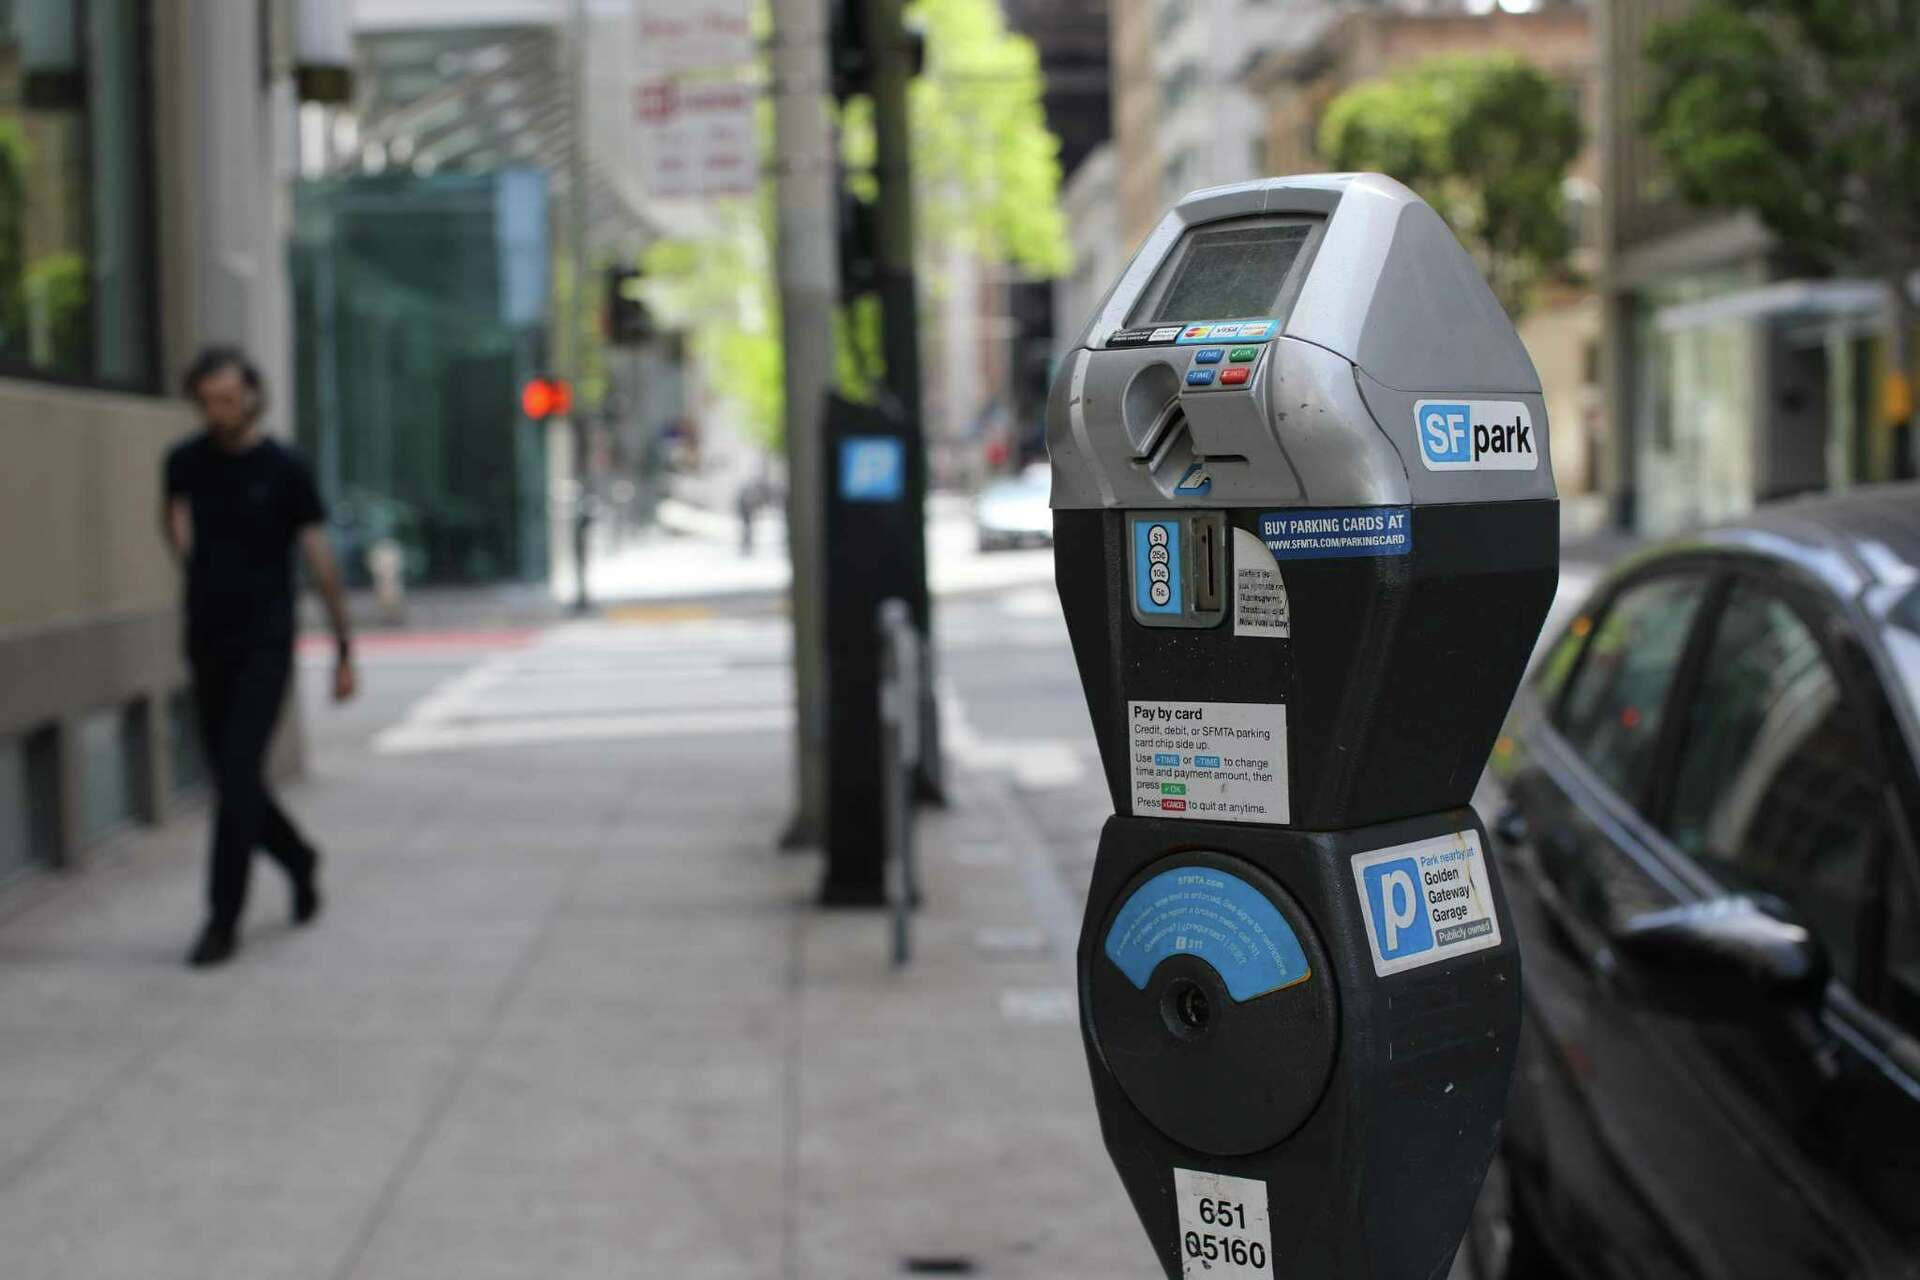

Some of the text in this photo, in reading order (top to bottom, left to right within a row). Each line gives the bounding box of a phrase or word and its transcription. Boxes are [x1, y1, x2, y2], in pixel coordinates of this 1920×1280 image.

[1264, 514, 1404, 535] BUY PARKING CARDS AT
[1134, 705, 1202, 722] Pay by card
[1134, 724, 1270, 741] Credit, debit, or SFMTA parking
[1135, 737, 1210, 751] card chip side up.
[1135, 753, 1152, 763] Use
[1182, 756, 1192, 765] or
[1224, 758, 1234, 767] to
[1235, 758, 1269, 770] change
[1135, 767, 1273, 782] time and payment amount, then
[1136, 780, 1160, 790] press
[1137, 797, 1161, 808] Press
[1188, 801, 1198, 809] to
[1199, 801, 1216, 812] quit
[1217, 802, 1227, 810] at
[1228, 802, 1267, 814] anytime.
[1420, 854, 1440, 867] Park
[1440, 848, 1465, 863] nearby
[1424, 868, 1459, 885] Golden
[1428, 884, 1470, 904] Gateway
[1432, 905, 1468, 923] Garage
[1439, 927, 1466, 943] Publicly
[1200, 1198, 1245, 1229] 651
